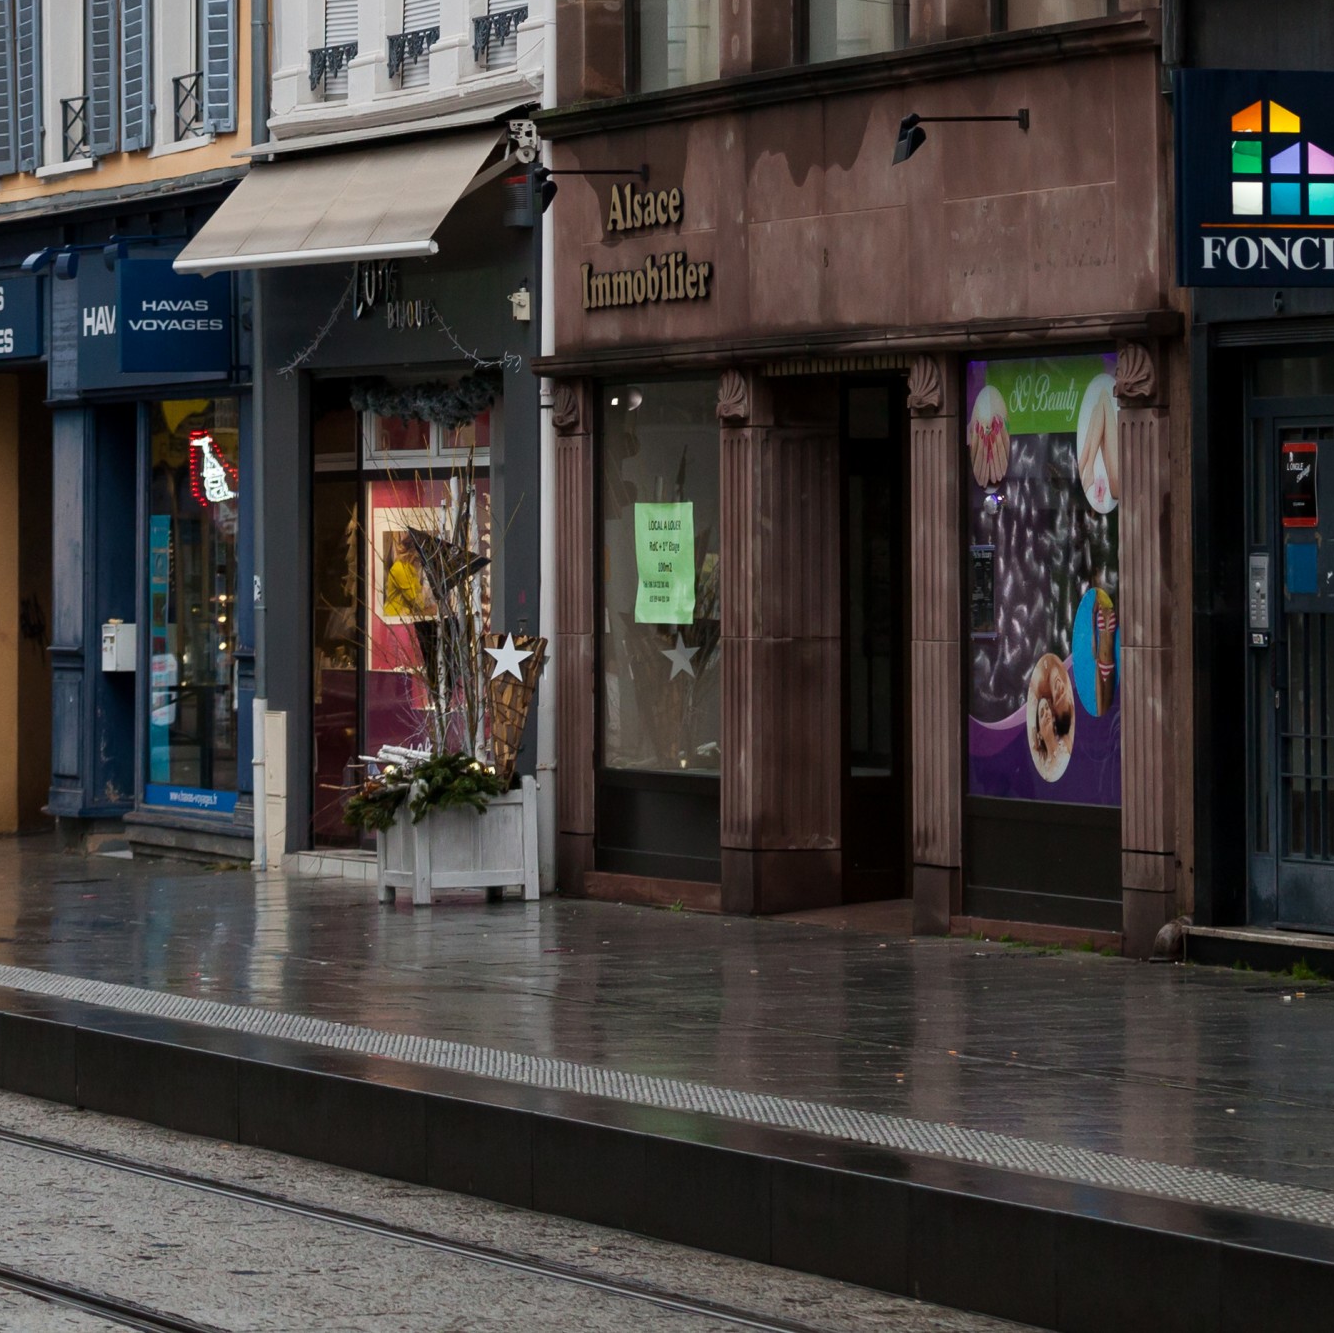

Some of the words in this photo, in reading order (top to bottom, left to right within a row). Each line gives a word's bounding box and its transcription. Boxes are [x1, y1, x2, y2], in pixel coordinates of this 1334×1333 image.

[607, 183, 682, 231] Alsace
[580, 252, 710, 310] Immobilier
[83, 304, 116, 337] HAV
[141, 299, 209, 312] HAVAS
[128, 319, 224, 331] VOYAGES
[1032, 374, 1080, 422] Beauty
[649, 520, 663, 531] LOCAL
[667, 520, 681, 531] LOUER
